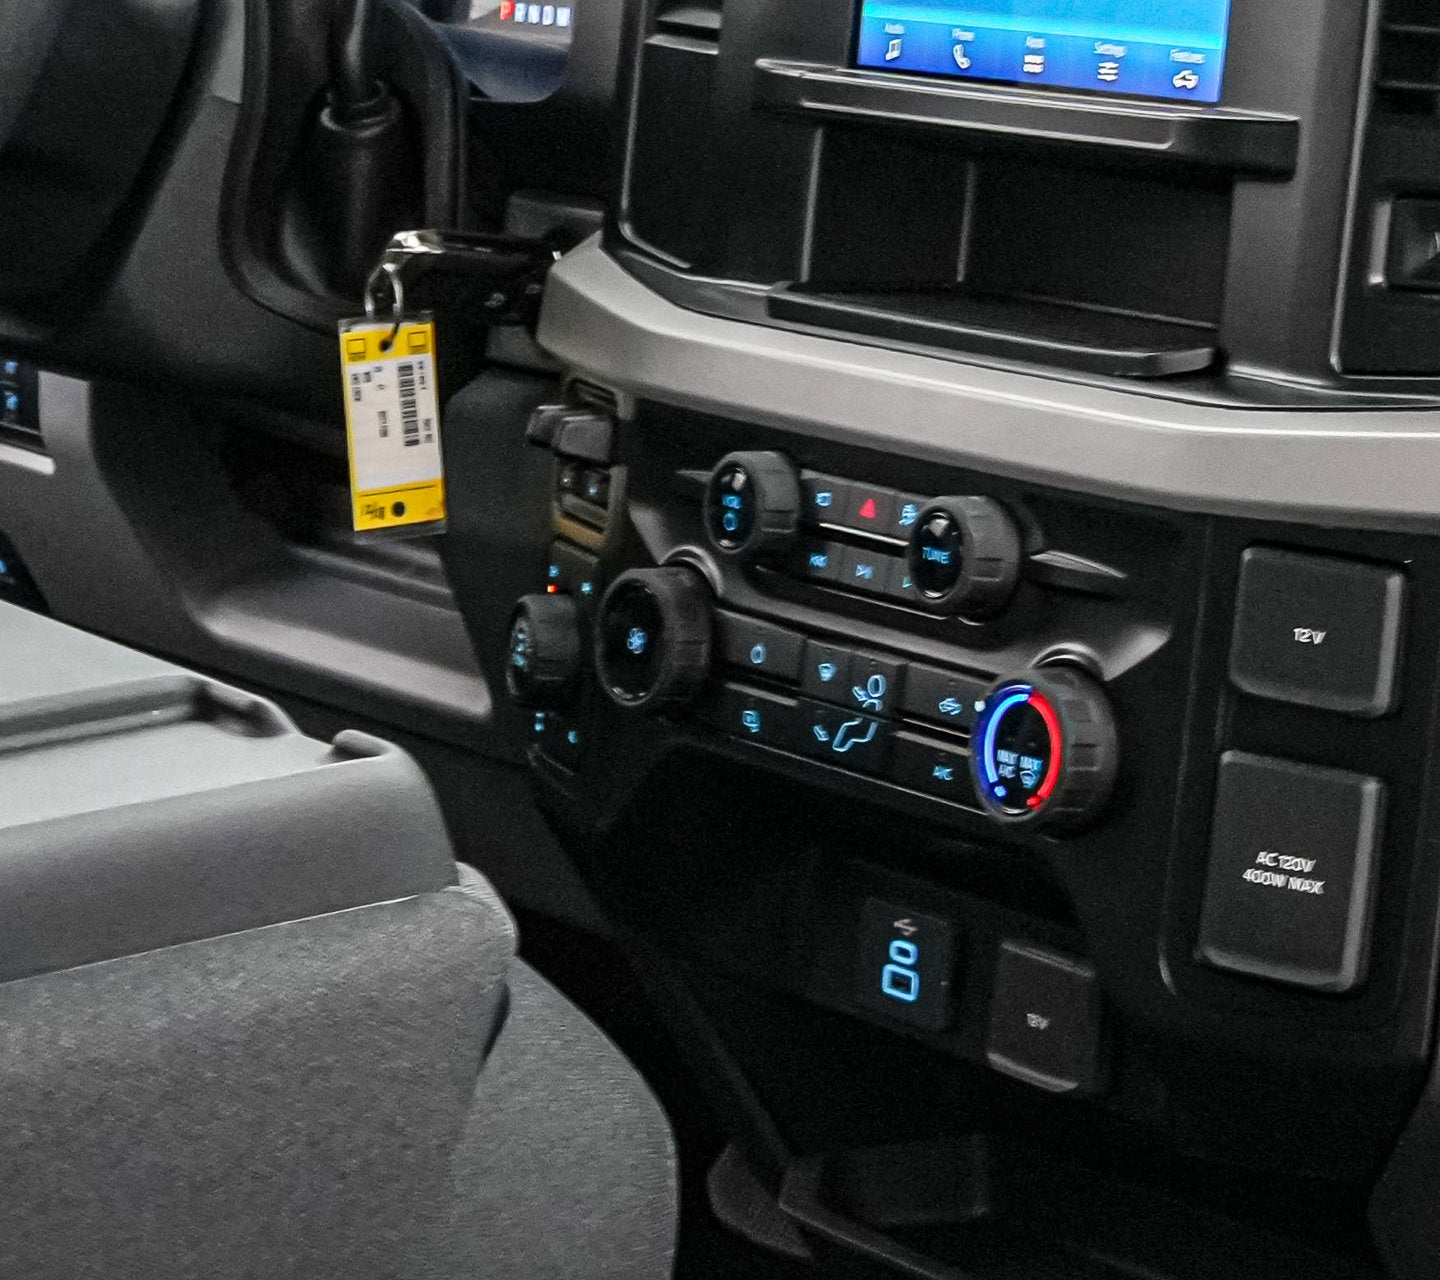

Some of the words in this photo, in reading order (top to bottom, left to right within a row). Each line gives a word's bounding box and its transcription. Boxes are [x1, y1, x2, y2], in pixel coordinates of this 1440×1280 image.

[922, 546, 952, 565] TUNE
[1293, 627, 1327, 645] 12V
[1255, 851, 1280, 867] AC
[1278, 854, 1317, 873] 120V
[1242, 868, 1289, 888] 400W
[1288, 876, 1326, 895] MAX
